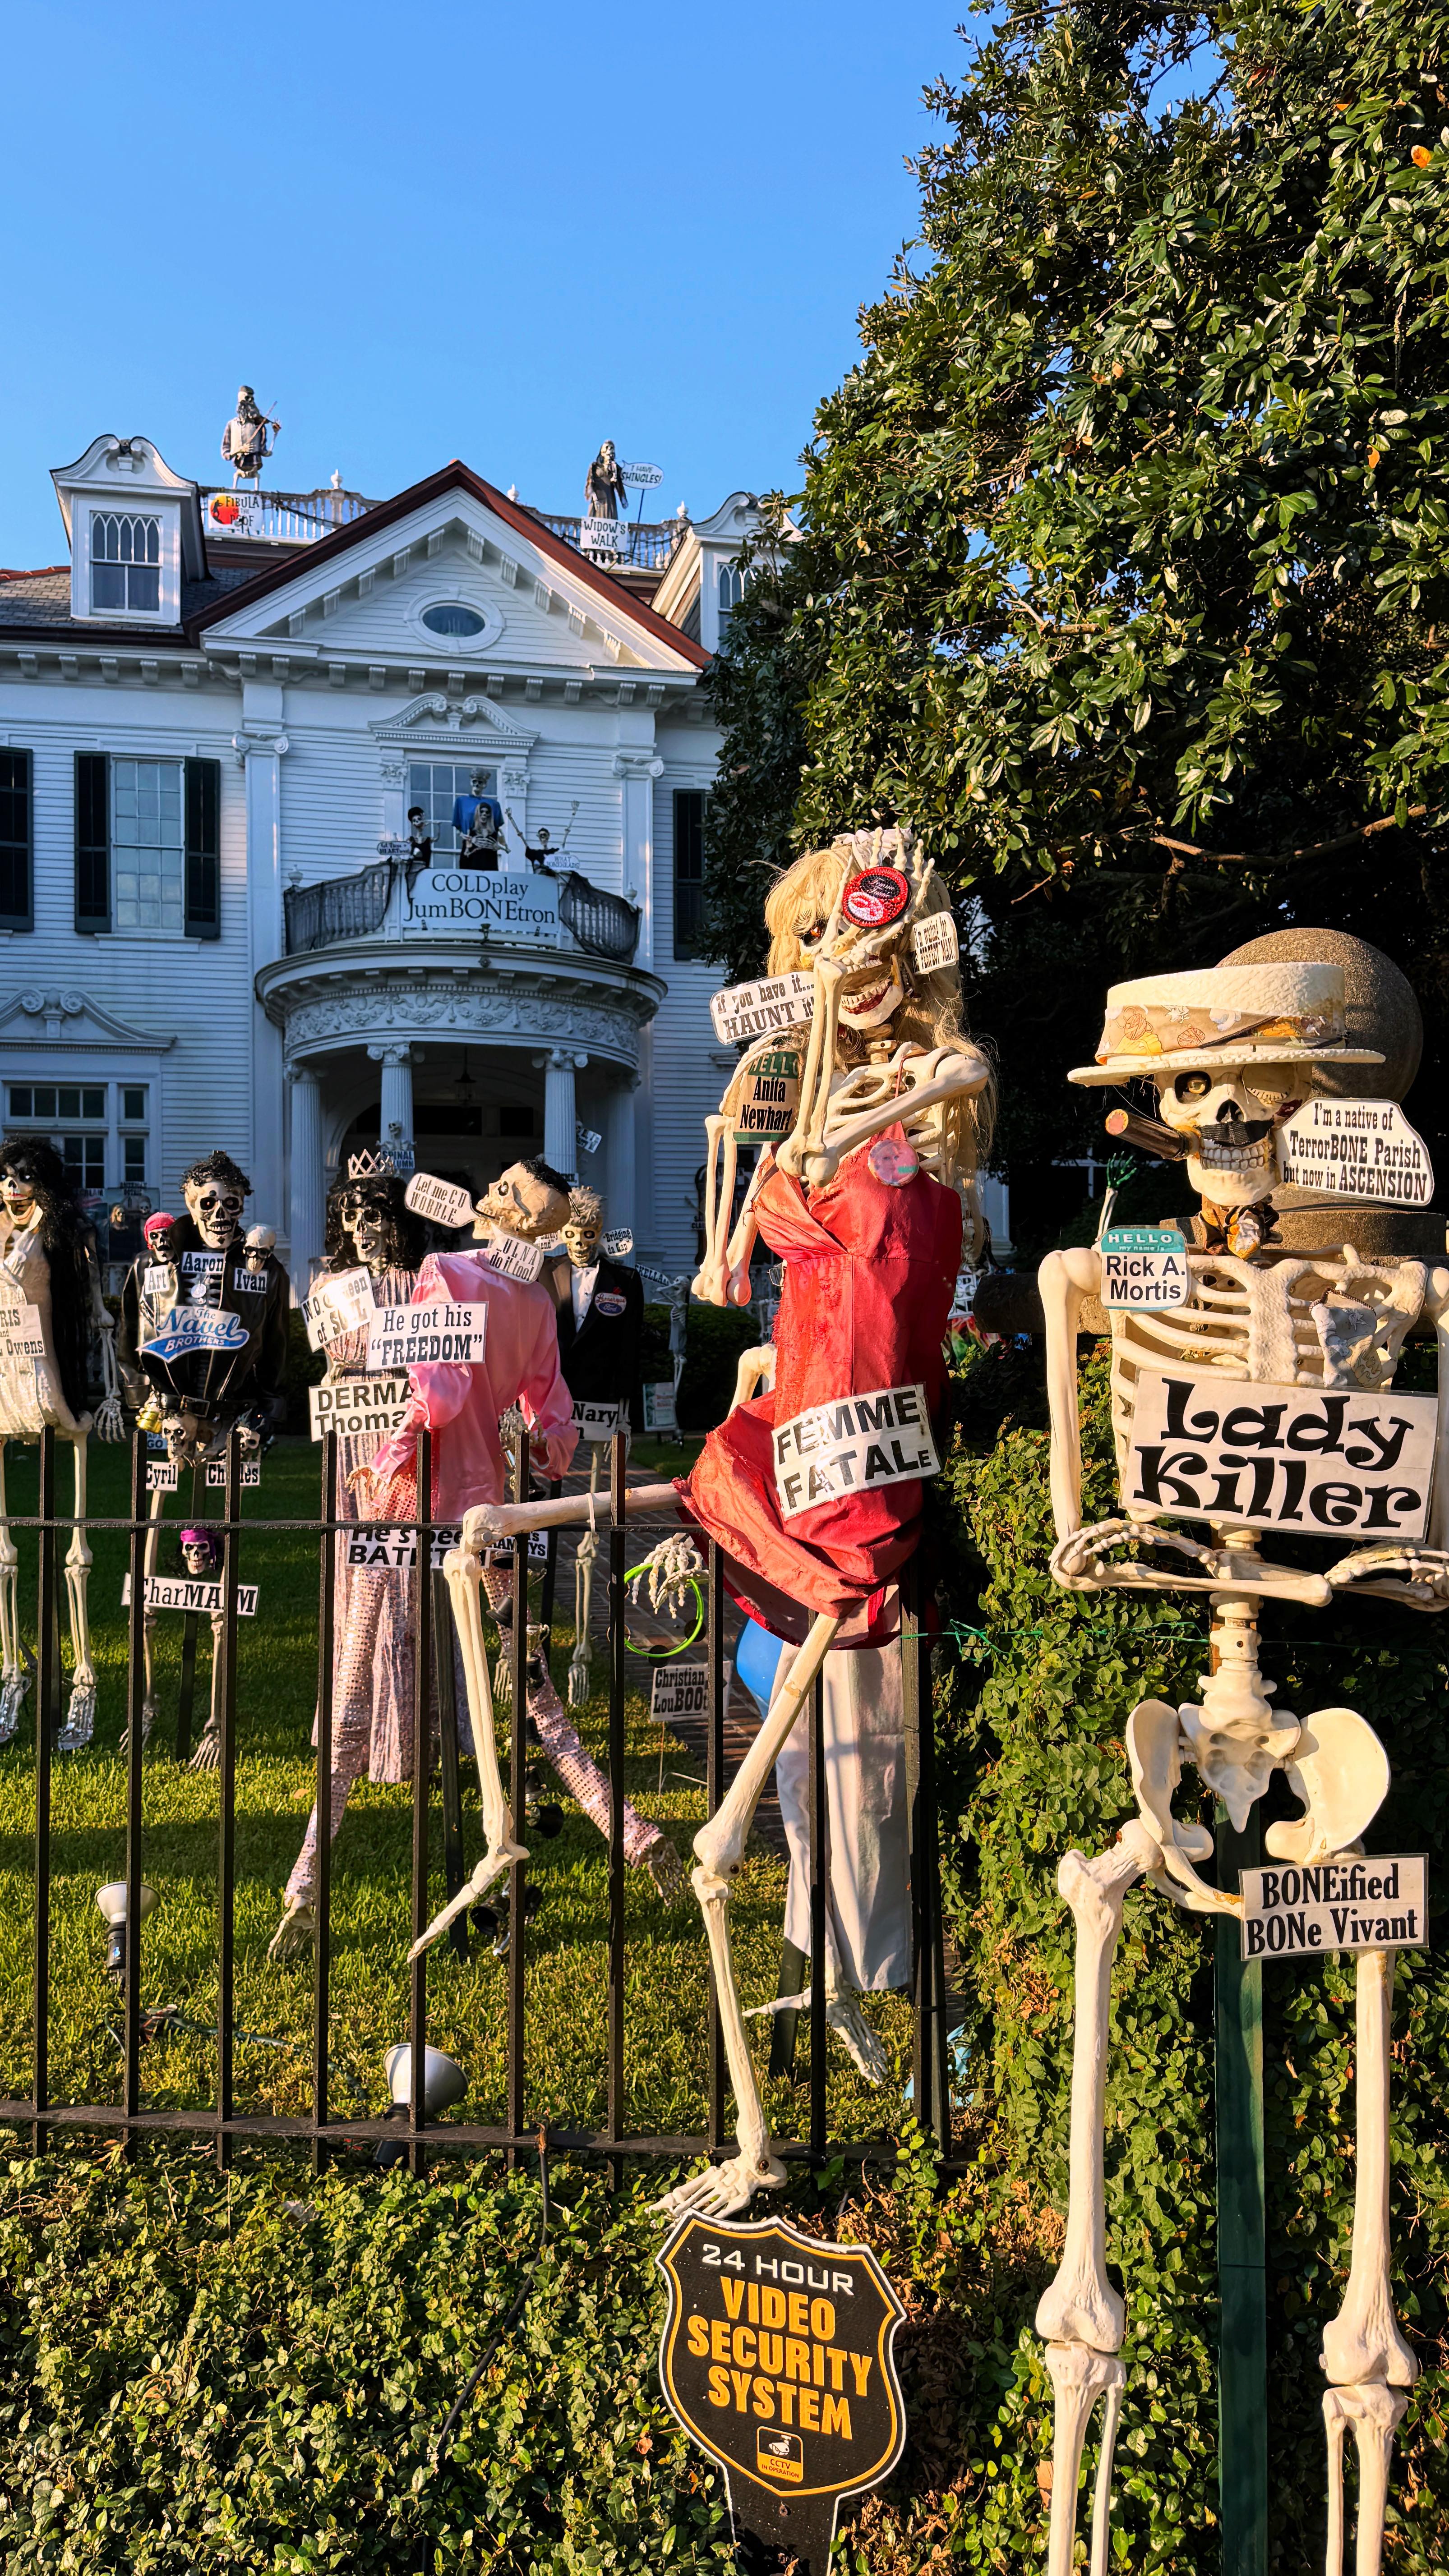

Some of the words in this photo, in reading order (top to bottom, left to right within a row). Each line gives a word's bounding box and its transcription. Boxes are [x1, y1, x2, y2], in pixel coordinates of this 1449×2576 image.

[621, 471, 662, 484] SHINGLES!
[636, 465, 654, 473] HAVE
[226, 496, 260, 509] FIBULA
[583, 519, 626, 535] WIDOW'S
[591, 533, 618, 547] WALK
[432, 874, 529, 901] COLDplay
[403, 897, 556, 924] JumBONEtron
[939, 915, 947, 938] for
[732, 991, 754, 1014] you
[757, 982, 786, 1003] have
[723, 1001, 795, 1040] HAUNT
[752, 1054, 799, 1076] HELLO
[752, 1076, 786, 1103] Anita
[739, 1104, 793, 1131] Newhart
[1314, 1102, 1332, 1127] I'm
[1335, 1109, 1342, 1127] a
[1345, 1105, 1378, 1130] native
[1382, 1107, 1394, 1131] of
[382, 1150, 413, 1160] SPINAL
[1290, 1130, 1368, 1164] TerrorBONE
[1374, 1137, 1421, 1169] Parish
[393, 1159, 414, 1168] LUMN
[415, 1175, 432, 1196] Let
[431, 1185, 448, 1201] me
[448, 1189, 458, 1205] C
[457, 1192, 468, 1208] U
[1283, 1160, 1299, 1184] but
[1302, 1168, 1324, 1188] now
[1326, 1166, 1336, 1190] in
[1338, 1164, 1427, 1202] ASCENSION
[607, 1245, 615, 1255] da
[1108, 1233, 1172, 1243] HELLO
[183, 1253, 224, 1272] Aaron
[489, 1252, 503, 1269] do
[503, 1256, 514, 1274] it
[512, 1261, 535, 1281] too!
[1106, 1255, 1155, 1277] Rick
[1162, 1256, 1186, 1276] A.
[148, 1269, 167, 1292] Art
[235, 1269, 267, 1292] Ivan
[1110, 1279, 1181, 1301] Mortis
[0, 1309, 21, 1327] RIS
[195, 1308, 216, 1320] The
[303, 1296, 324, 1323] N.O.
[383, 1309, 405, 1332] He
[411, 1307, 438, 1334] got
[444, 1304, 472, 1327] his
[603, 1303, 618, 1312] Ford
[156, 1308, 243, 1339] Navel
[317, 1321, 328, 1344] of
[6, 1339, 43, 1356] Owens
[164, 1335, 225, 1353] BROTHERS
[318, 1380, 412, 1412] DERMA
[315, 1410, 407, 1436] Thoma
[777, 1390, 921, 1465] FEMME
[1160, 1377, 1414, 1472] Lady
[146, 1463, 176, 1489] Cyril
[208, 1463, 259, 1484] Chles
[783, 1440, 932, 1509] FATALE
[1133, 1445, 1422, 1529] Killer
[655, 1667, 705, 1689] Christian
[653, 1686, 709, 1714] LouBOOt
[1261, 1863, 1400, 1909] BONEified
[1246, 1911, 1322, 1955] BONe
[1329, 1907, 1418, 1944] Vivant
[702, 2243, 746, 2271] 24
[756, 2255, 854, 2295] HOUR
[720, 2276, 836, 2341] VIDEO
[687, 2315, 873, 2397] SECURITY
[708, 2365, 853, 2440] SYSTEM
[768, 2466, 799, 2479] OPERATION
[770, 2458, 791, 2470] CCTV
